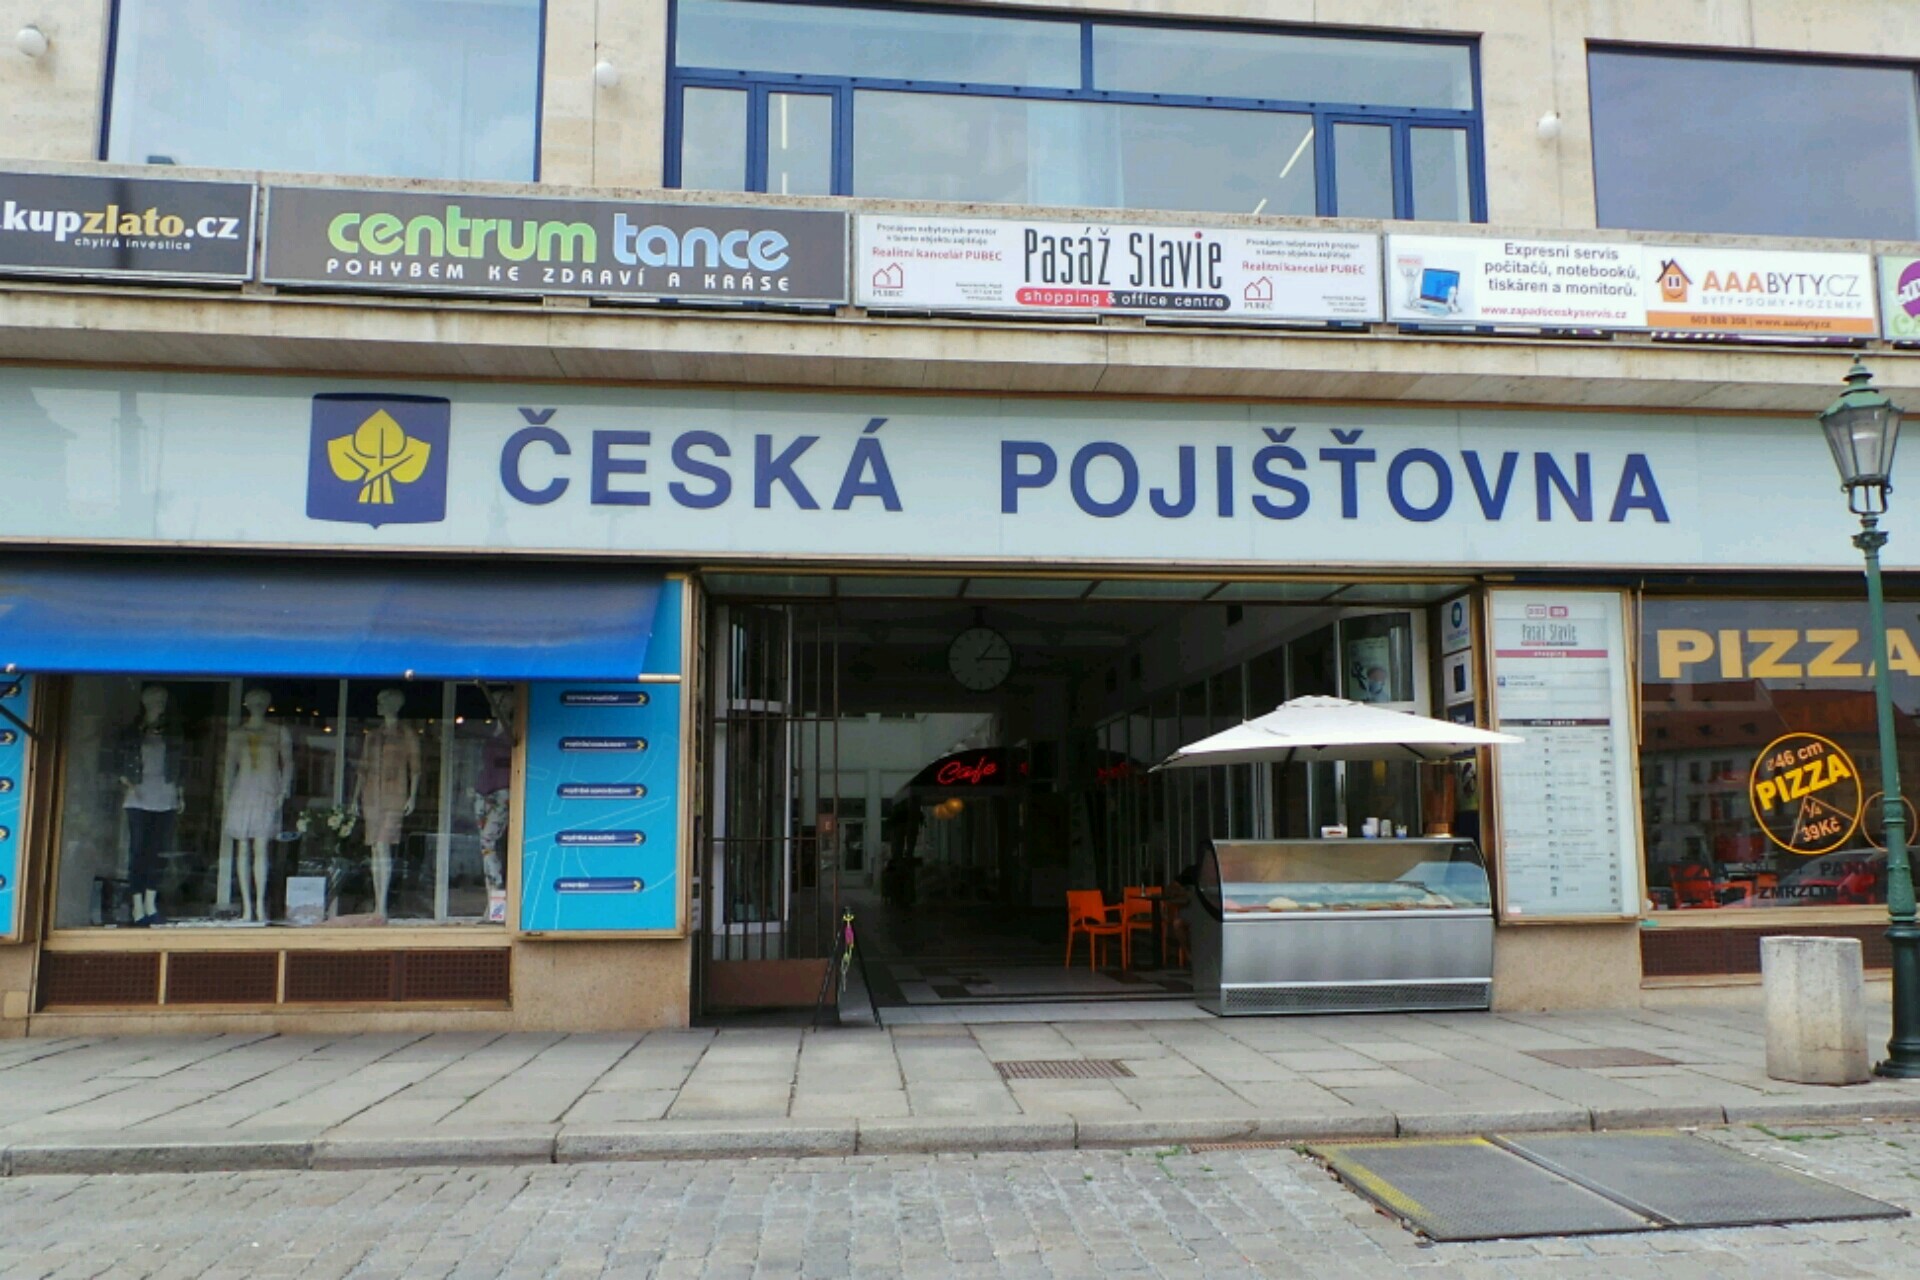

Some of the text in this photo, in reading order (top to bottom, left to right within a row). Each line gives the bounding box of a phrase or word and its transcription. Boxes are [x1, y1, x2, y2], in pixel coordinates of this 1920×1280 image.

[0, 201, 239, 241] kupzlato.cz
[74, 236, 192, 251] chytrá investice
[328, 205, 789, 271] centrum tance
[965, 250, 1003, 261] PUBEC
[1024, 226, 1222, 289] Pasáž Slavie
[1504, 243, 1620, 260] Expresní servis
[327, 258, 790, 292] POHYBEM KE ZDRAVÍ A KRÁSE
[1330, 264, 1366, 275] PUBEC
[1556, 265, 1641, 281] notebooků,
[1489, 278, 1637, 297] tiskáren a monitorů.
[1024, 291, 1225, 308] shopping & office centre
[500, 408, 1670, 523] ČESKÁ POJIŠŤOVNA
[1657, 629, 1920, 678] PIZZA
[1797, 742, 1824, 760] cm
[1756, 754, 1851, 811] PIZZA
